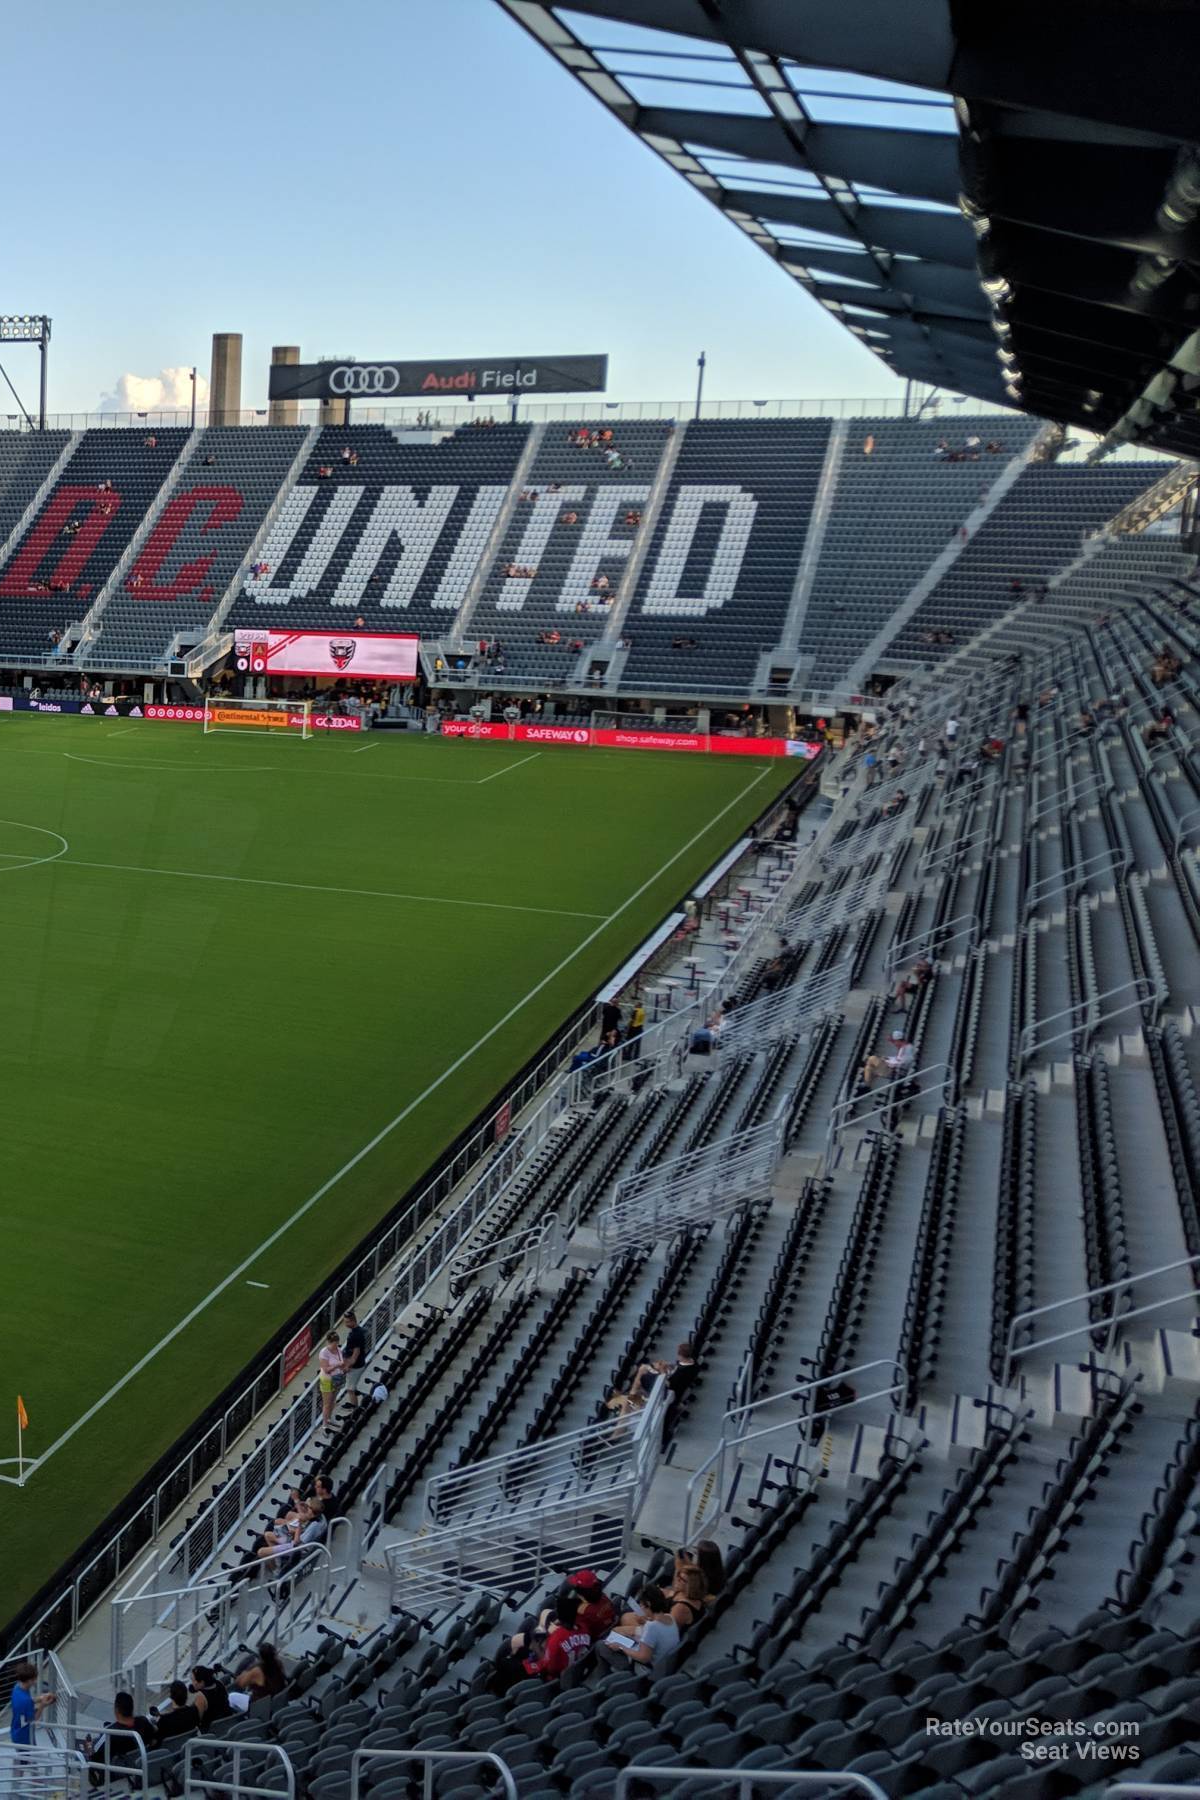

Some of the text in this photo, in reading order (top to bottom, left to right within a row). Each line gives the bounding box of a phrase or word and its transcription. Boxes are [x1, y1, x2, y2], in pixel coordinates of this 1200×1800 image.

[421, 369, 537, 389] Audi Field
[243, 486, 759, 616] UNITED
[237, 658, 265, 671] 0 0
[38, 702, 61, 713] leidos
[290, 717, 311, 725] Aui
[444, 725, 467, 734] your
[526, 728, 574, 740] SAFEWAY
[616, 735, 698, 746] shop.safeway.com
